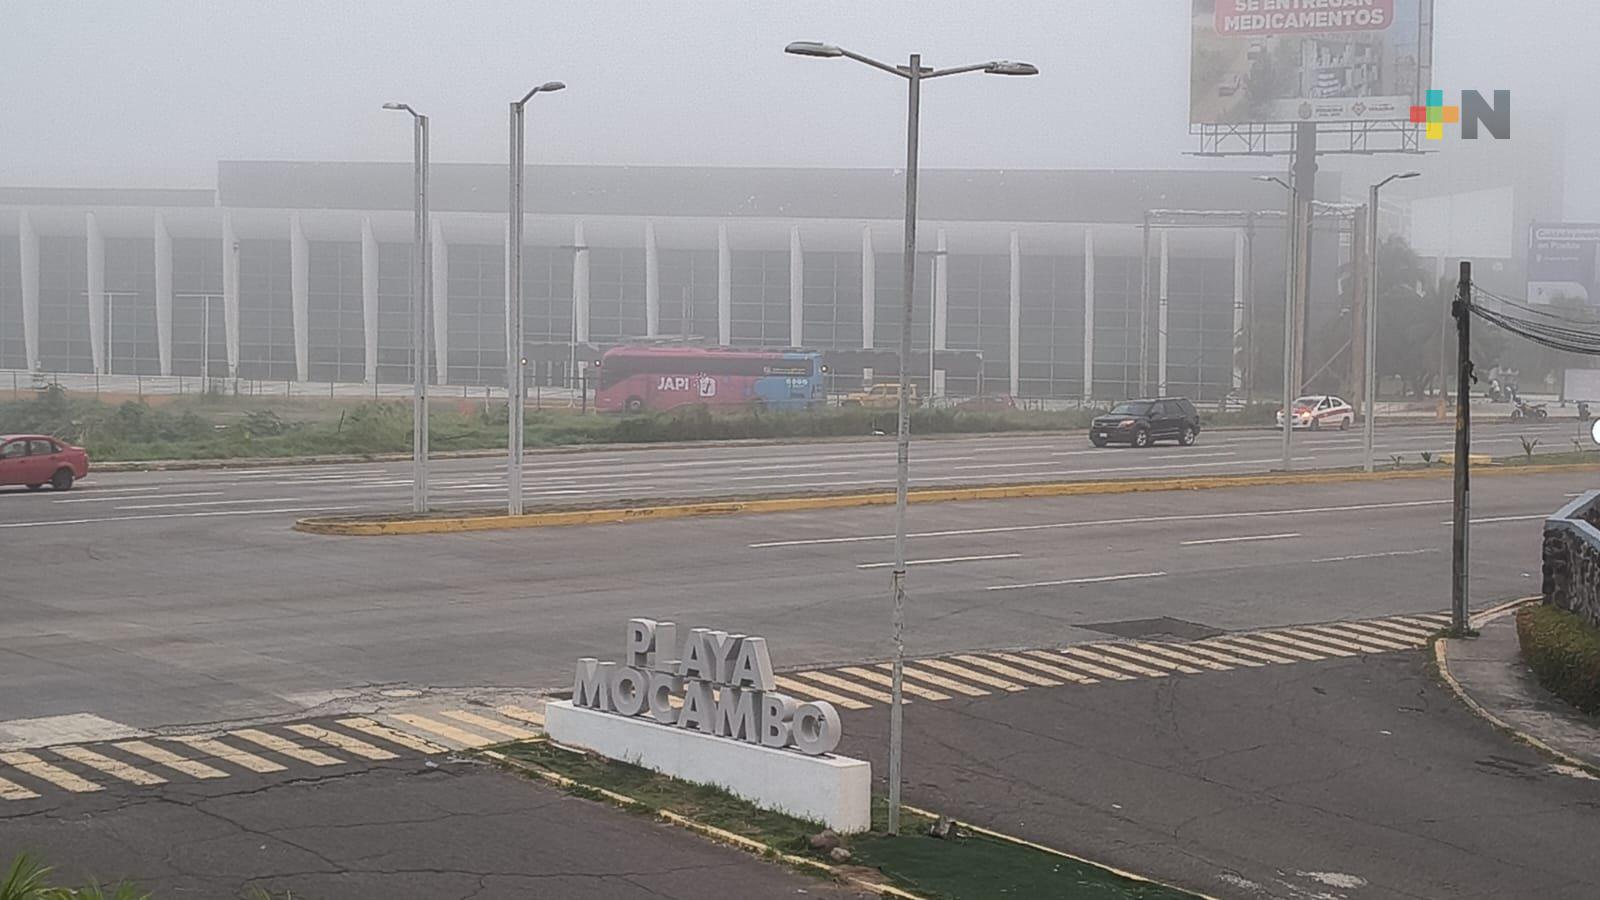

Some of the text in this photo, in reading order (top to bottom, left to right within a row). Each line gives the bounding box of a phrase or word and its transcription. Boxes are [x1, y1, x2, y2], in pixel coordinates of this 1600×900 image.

[1235, 0, 1260, 11] SE
[1224, 9, 1384, 31] MEDICAMENTOS
[657, 377, 689, 391] JAPI
[626, 618, 776, 691] PLAYA
[572, 657, 842, 755] MOCAMBO
